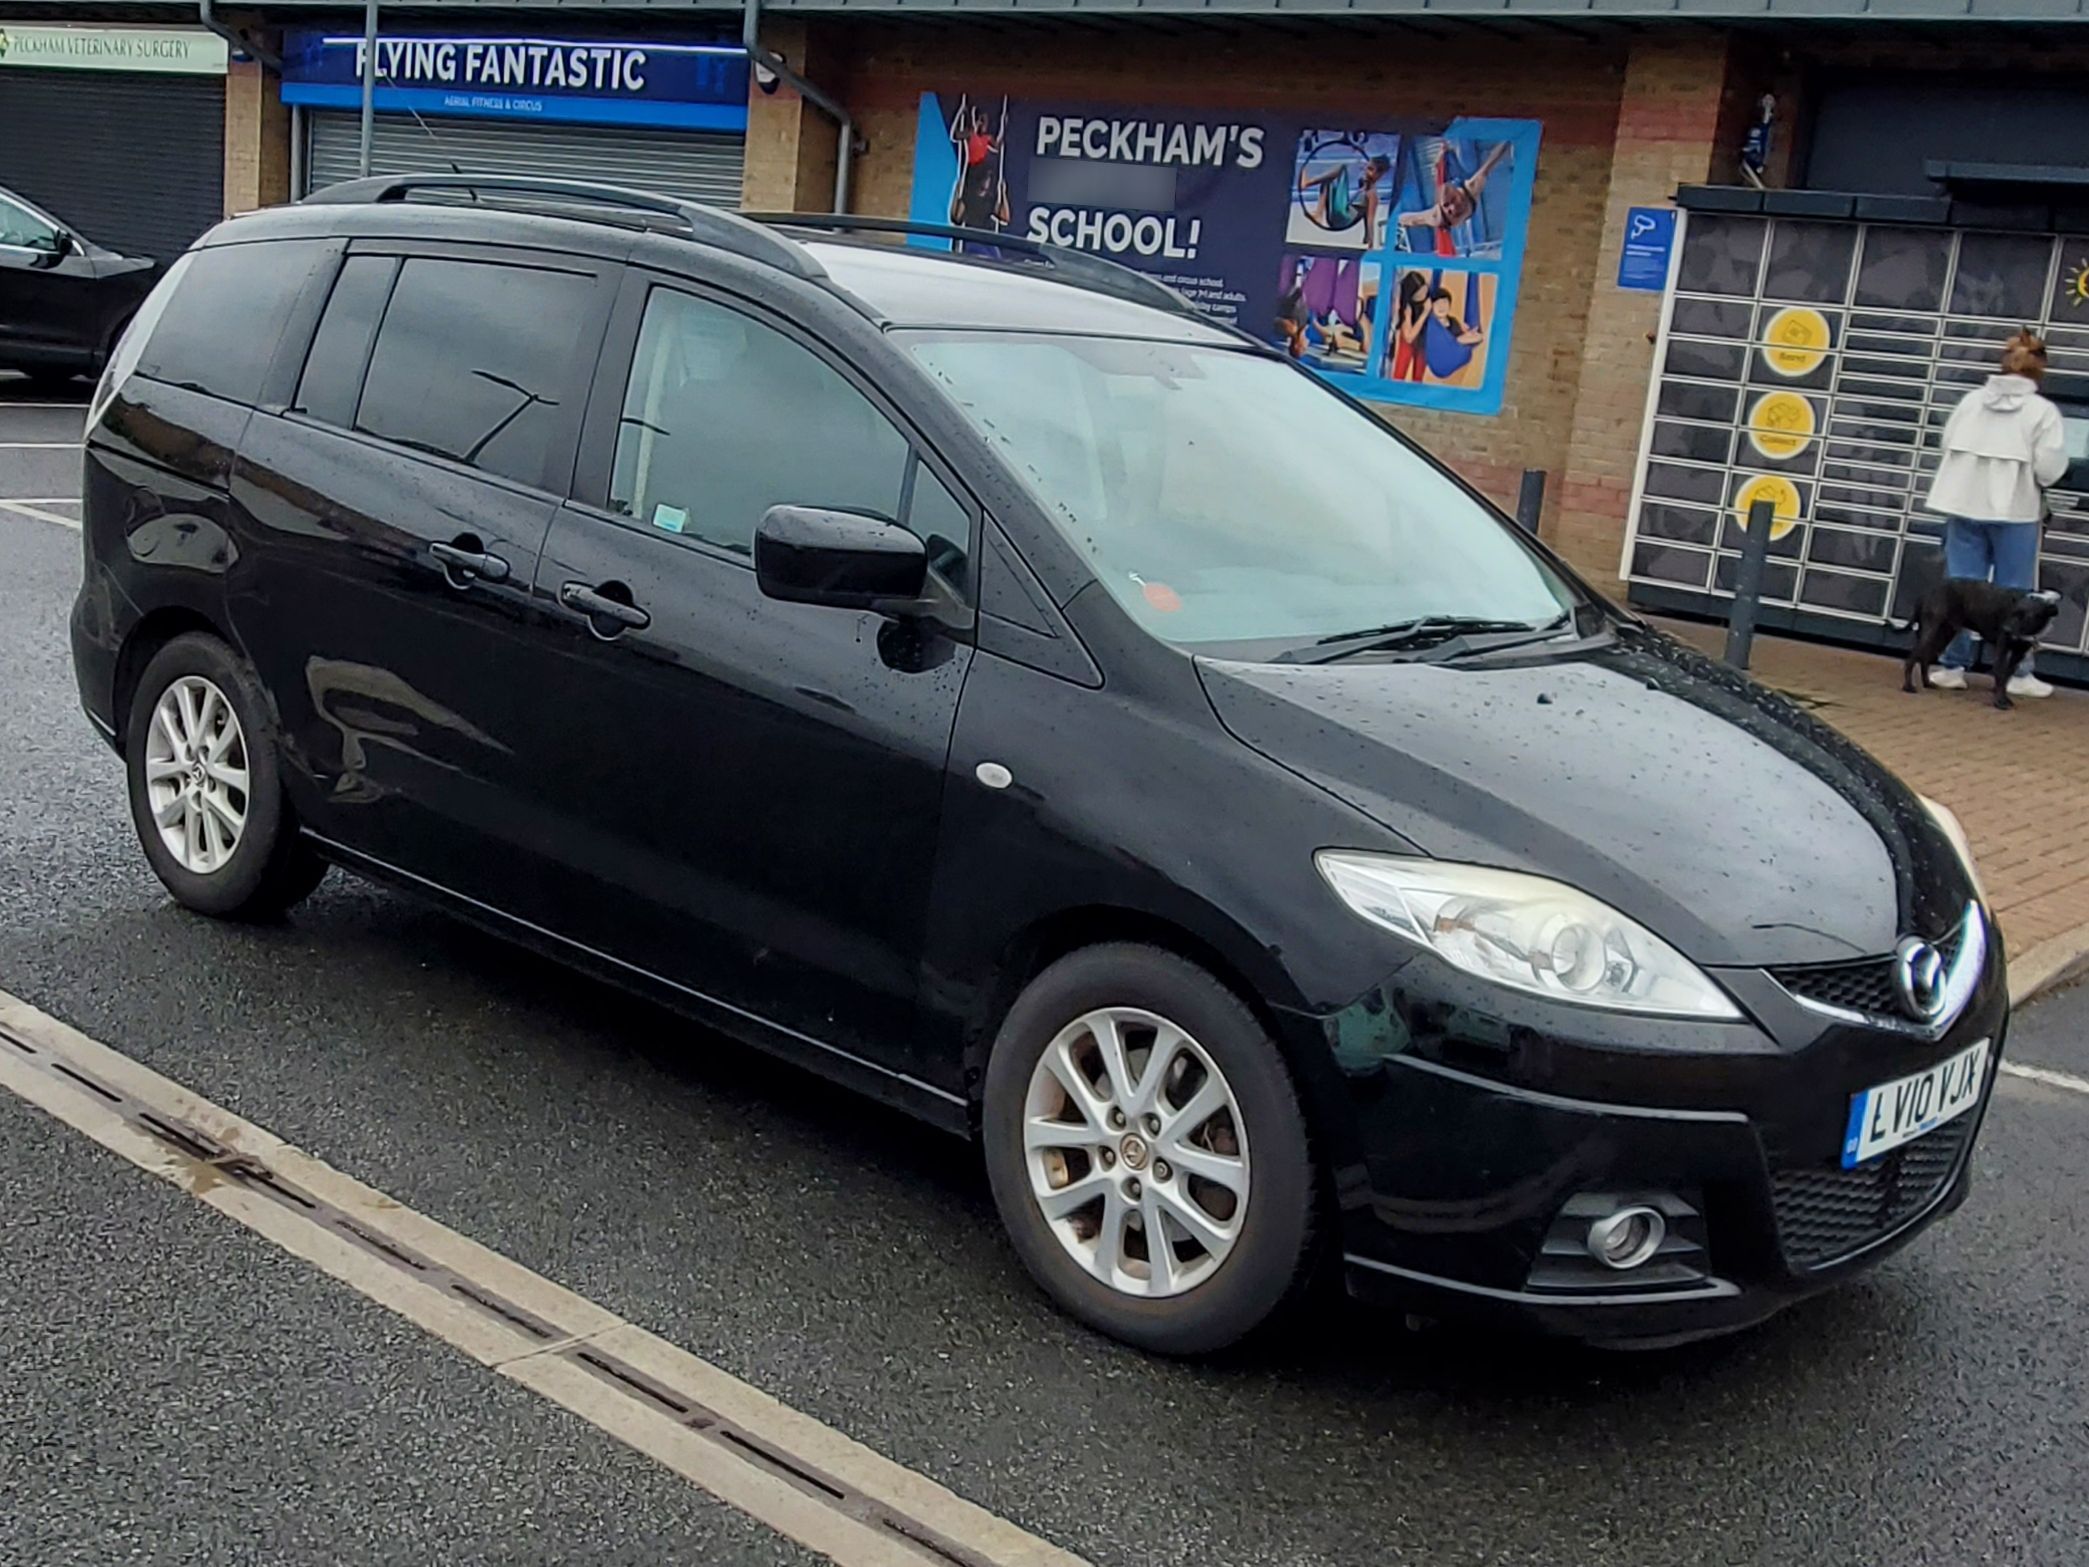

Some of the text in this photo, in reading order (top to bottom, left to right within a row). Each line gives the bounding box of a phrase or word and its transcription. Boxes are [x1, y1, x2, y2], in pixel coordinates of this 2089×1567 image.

[67, 37, 132, 57] VETERINARY
[135, 39, 191, 59] SURGERY
[355, 42, 646, 91] FLYING FANTASTIC
[1036, 116, 1265, 168] PECKHAM'S
[1026, 206, 1201, 260] SCHOOL!
[1869, 1047, 1981, 1143] LV10 VJX
